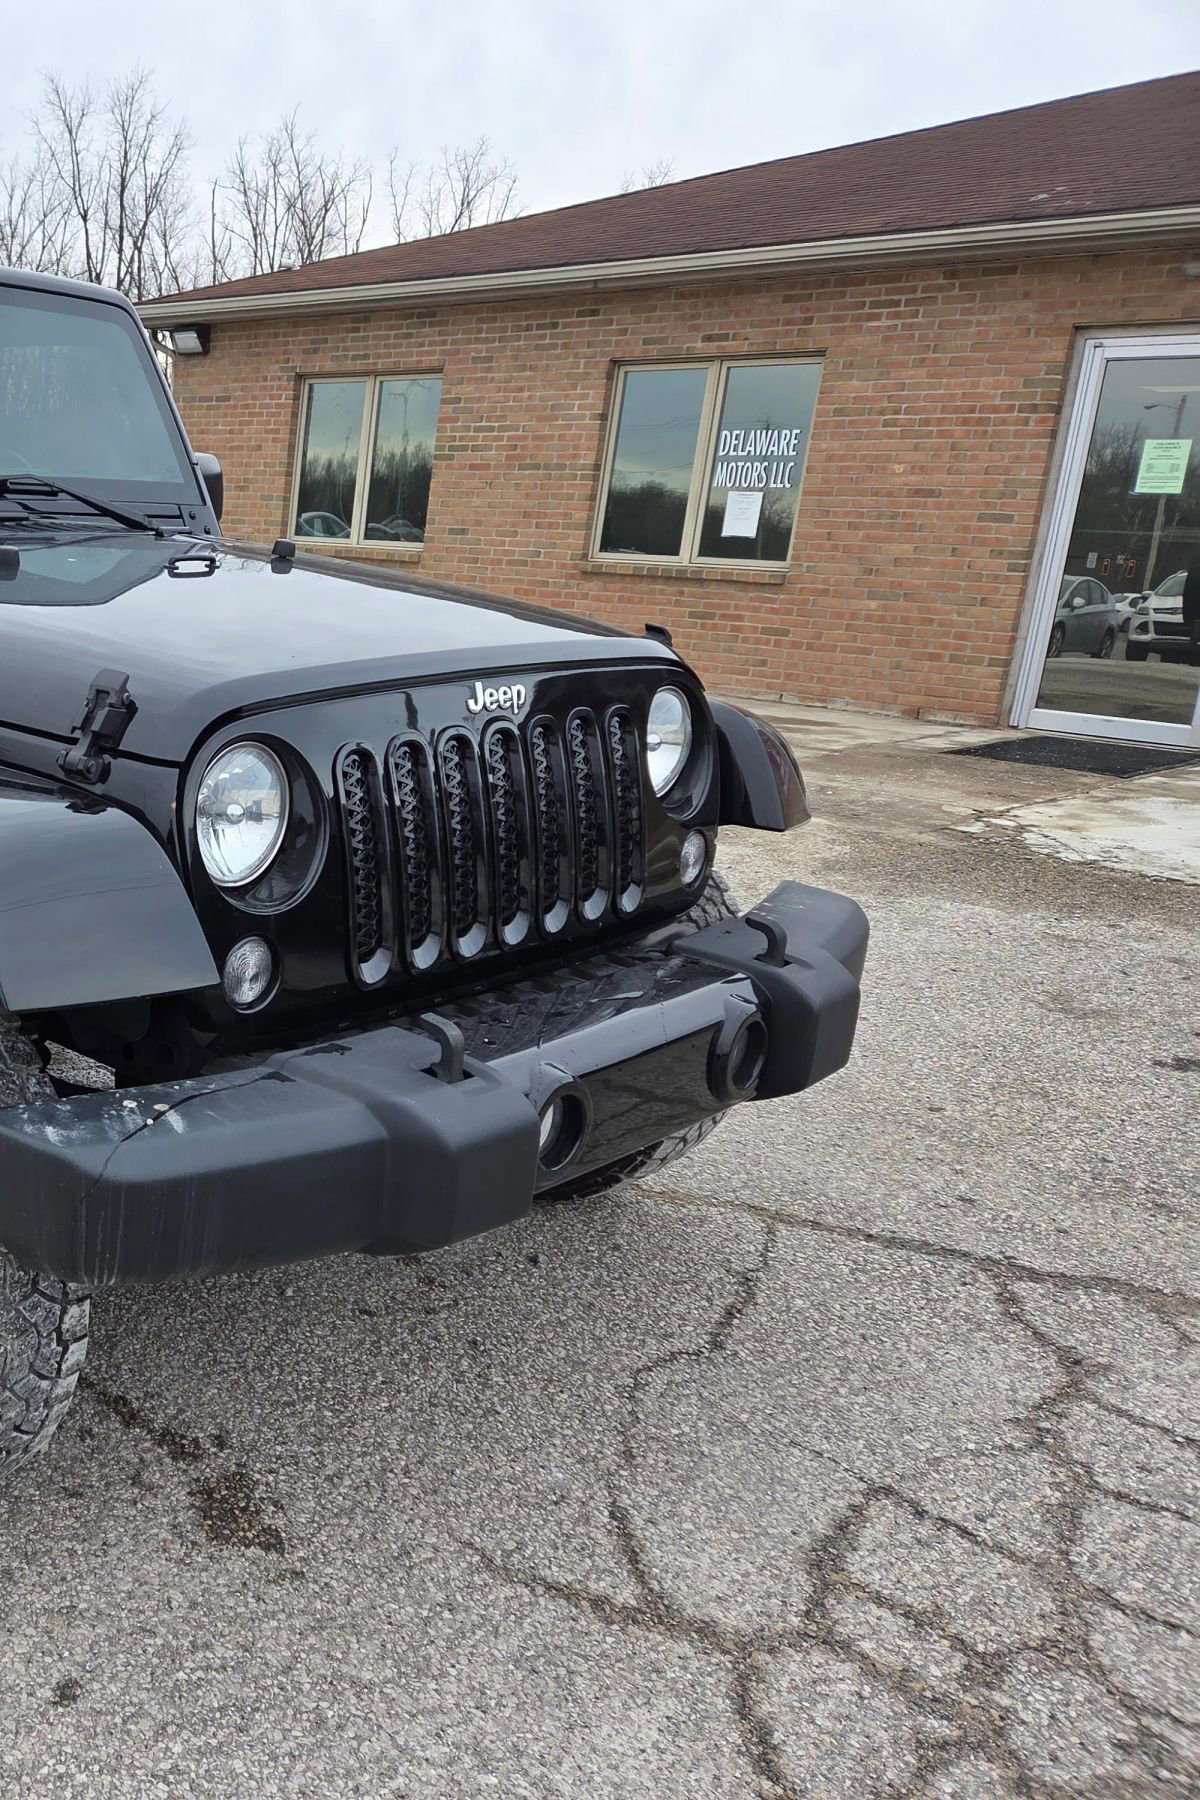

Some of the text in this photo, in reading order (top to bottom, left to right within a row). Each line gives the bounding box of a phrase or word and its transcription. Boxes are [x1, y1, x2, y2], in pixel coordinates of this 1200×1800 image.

[718, 429, 801, 456] DELAWARE
[713, 461, 795, 488] MOTORS LLC
[467, 681, 526, 714] Jeep
